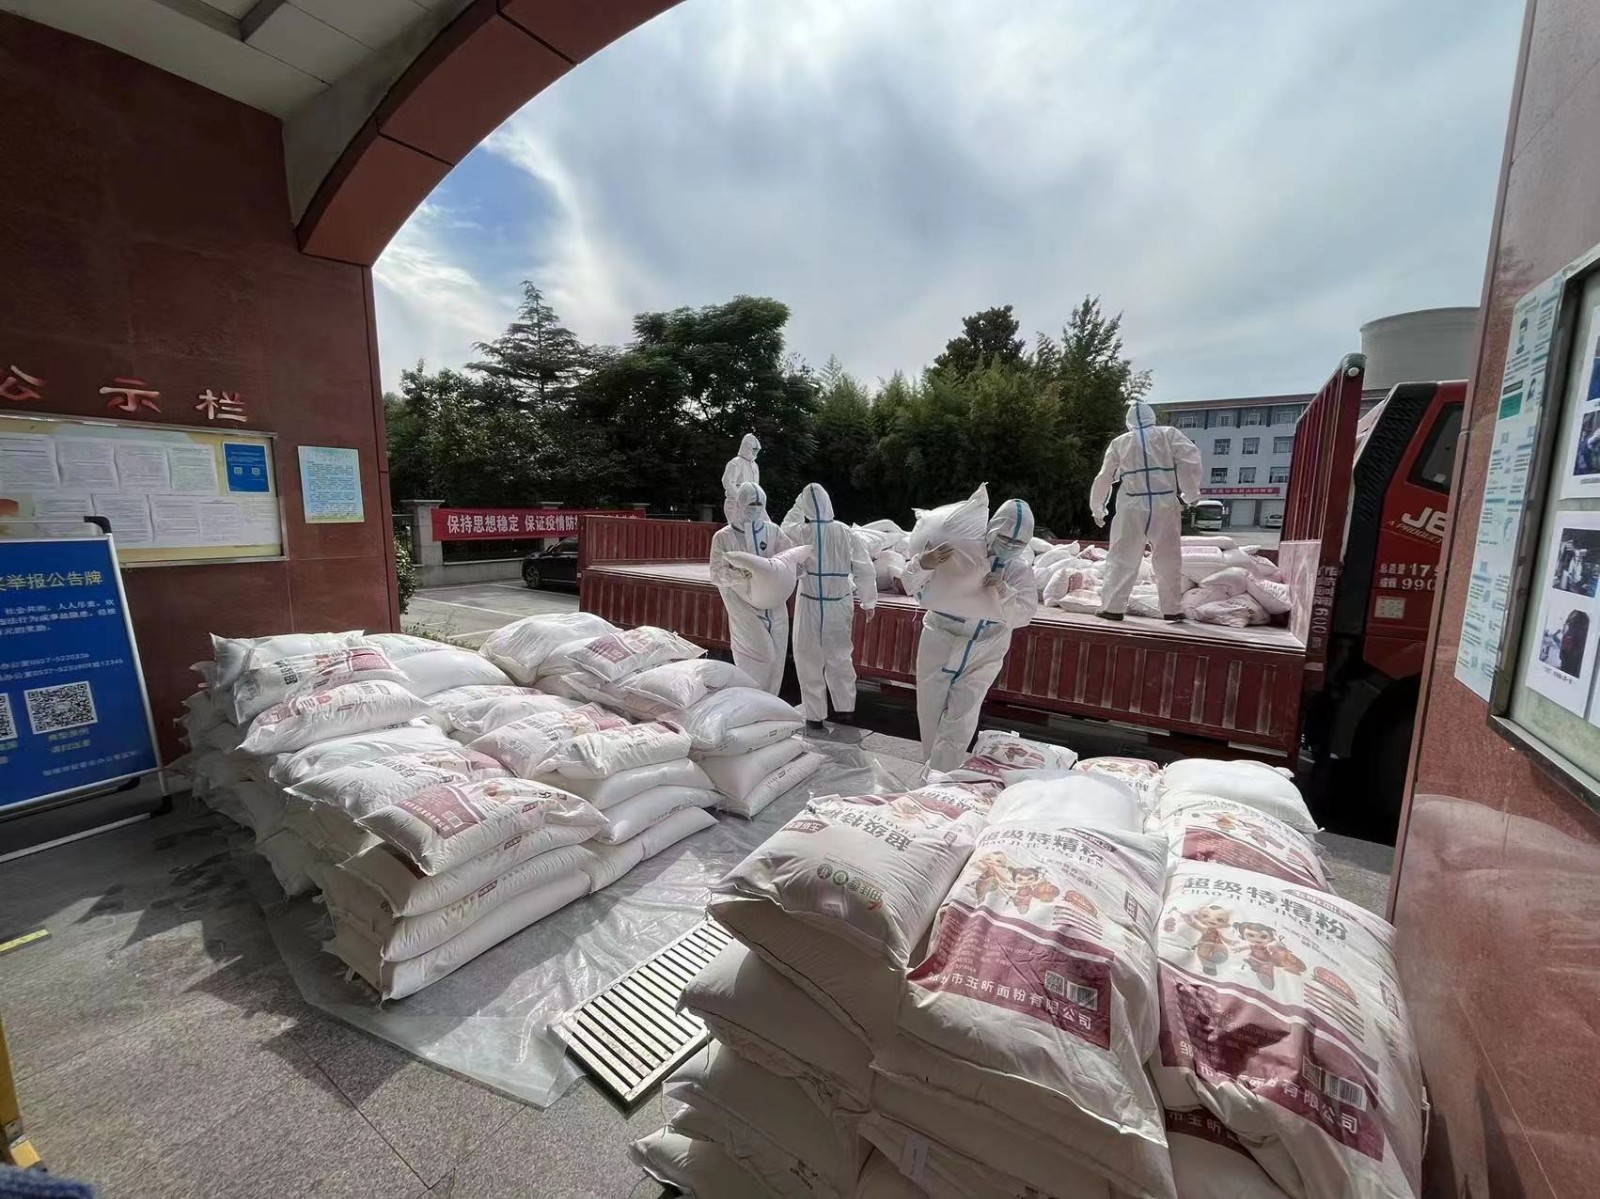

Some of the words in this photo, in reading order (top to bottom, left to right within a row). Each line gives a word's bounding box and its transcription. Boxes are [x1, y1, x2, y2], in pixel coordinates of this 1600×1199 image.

[446, 514, 520, 534] 保持思想稳定
[523, 514, 579, 532] 保证疫情防
[1311, 607, 1329, 634] 600
[1181, 888, 1223, 897] CHAO
[1182, 877, 1348, 941] 超级特精粉
